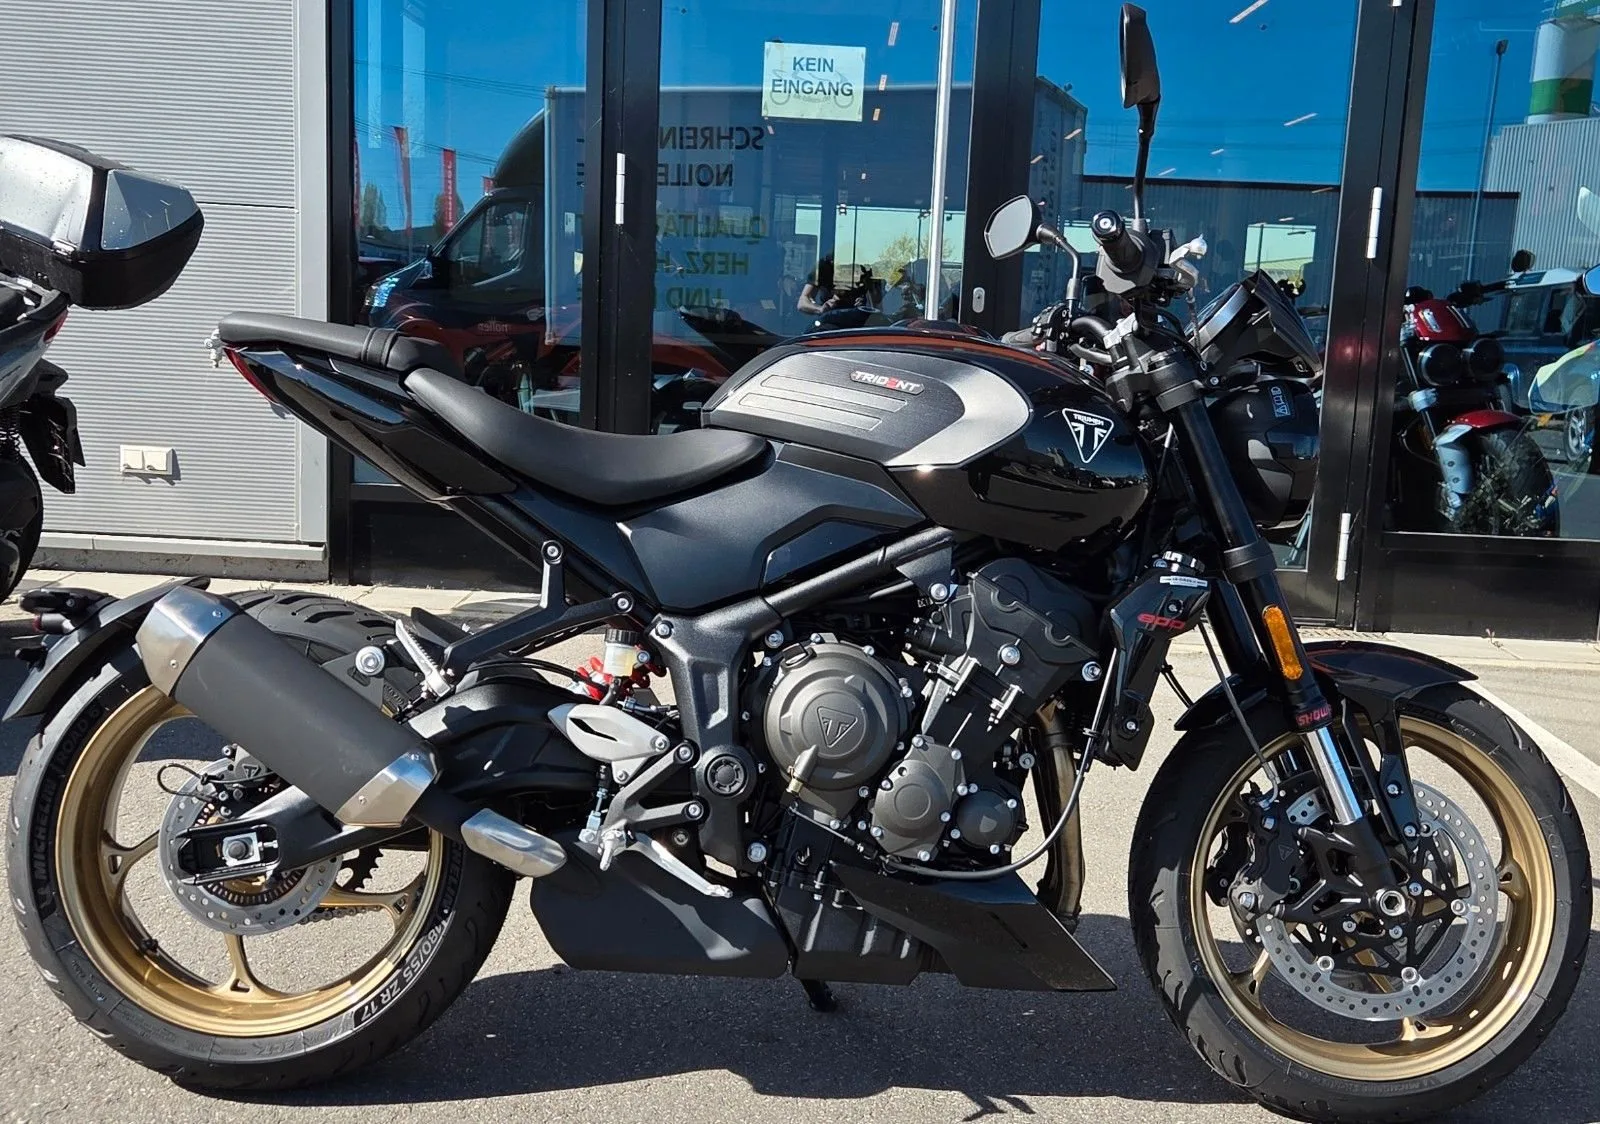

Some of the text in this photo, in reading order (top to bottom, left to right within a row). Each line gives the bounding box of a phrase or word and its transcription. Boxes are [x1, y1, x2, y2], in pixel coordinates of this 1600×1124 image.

[792, 56, 834, 72] KEIN
[771, 79, 853, 96] EINGANG
[854, 370, 921, 392] TRIDENT
[1296, 706, 1331, 726] SHOW
[360, 919, 448, 1022] 180/55 ZR 17
